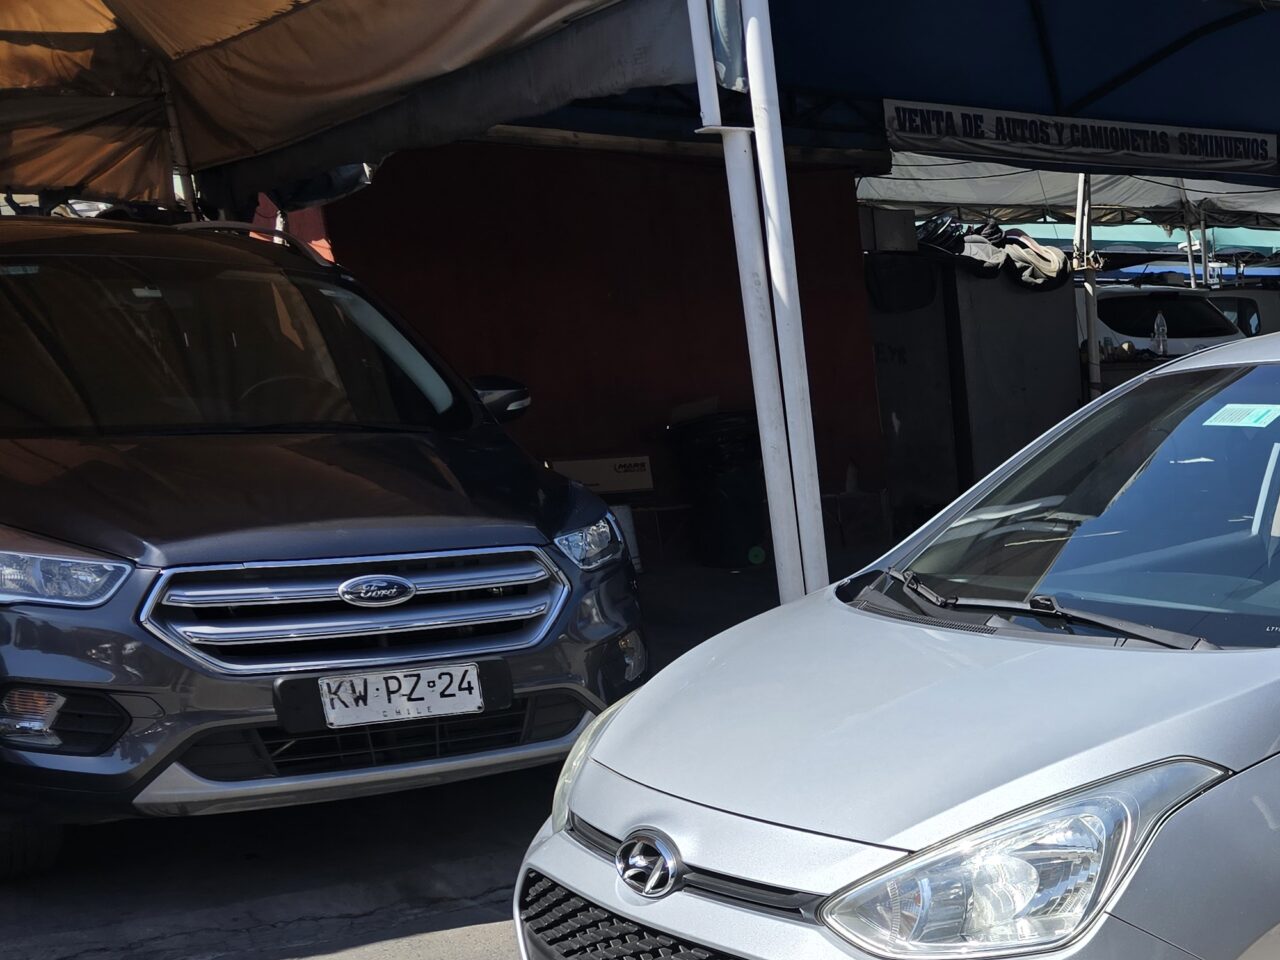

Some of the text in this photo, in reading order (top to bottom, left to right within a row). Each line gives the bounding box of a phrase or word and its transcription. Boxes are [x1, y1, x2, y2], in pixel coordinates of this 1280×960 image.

[895, 107, 1269, 161] VENTA DE AUTOS Y CAMIONETAS SEMINUEVOS
[360, 580, 399, 598] Ford
[382, 705, 433, 718] CHILE
